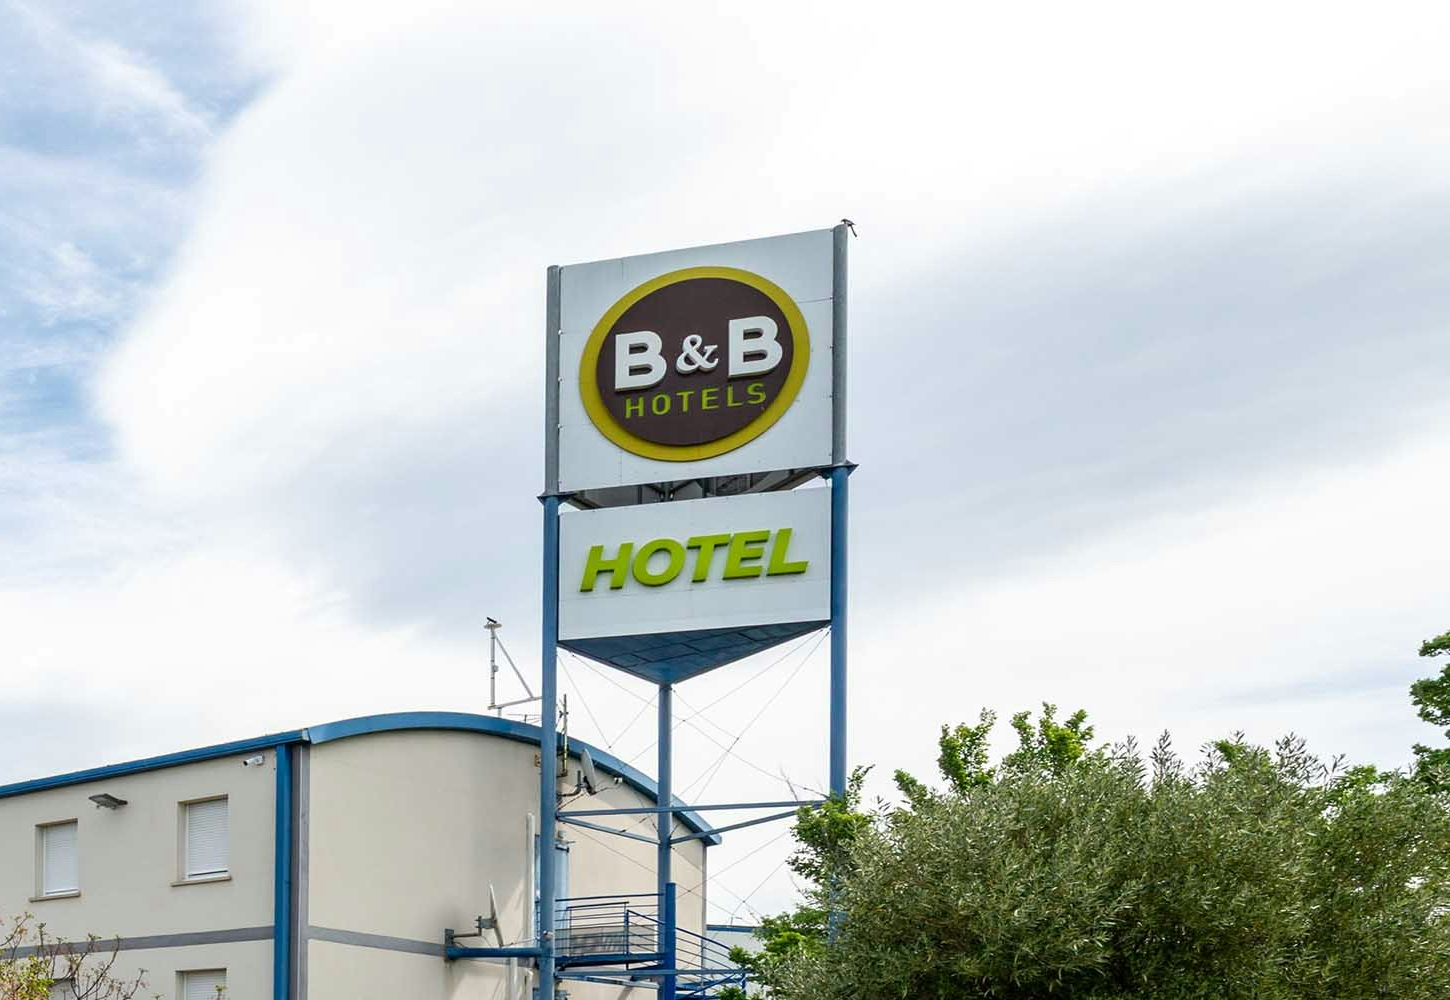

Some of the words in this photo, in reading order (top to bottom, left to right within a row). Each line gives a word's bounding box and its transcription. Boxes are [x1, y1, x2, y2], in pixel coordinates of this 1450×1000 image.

[614, 315, 783, 392] B&B
[625, 383, 767, 419] HOTELS
[580, 528, 809, 592] HOTEL
